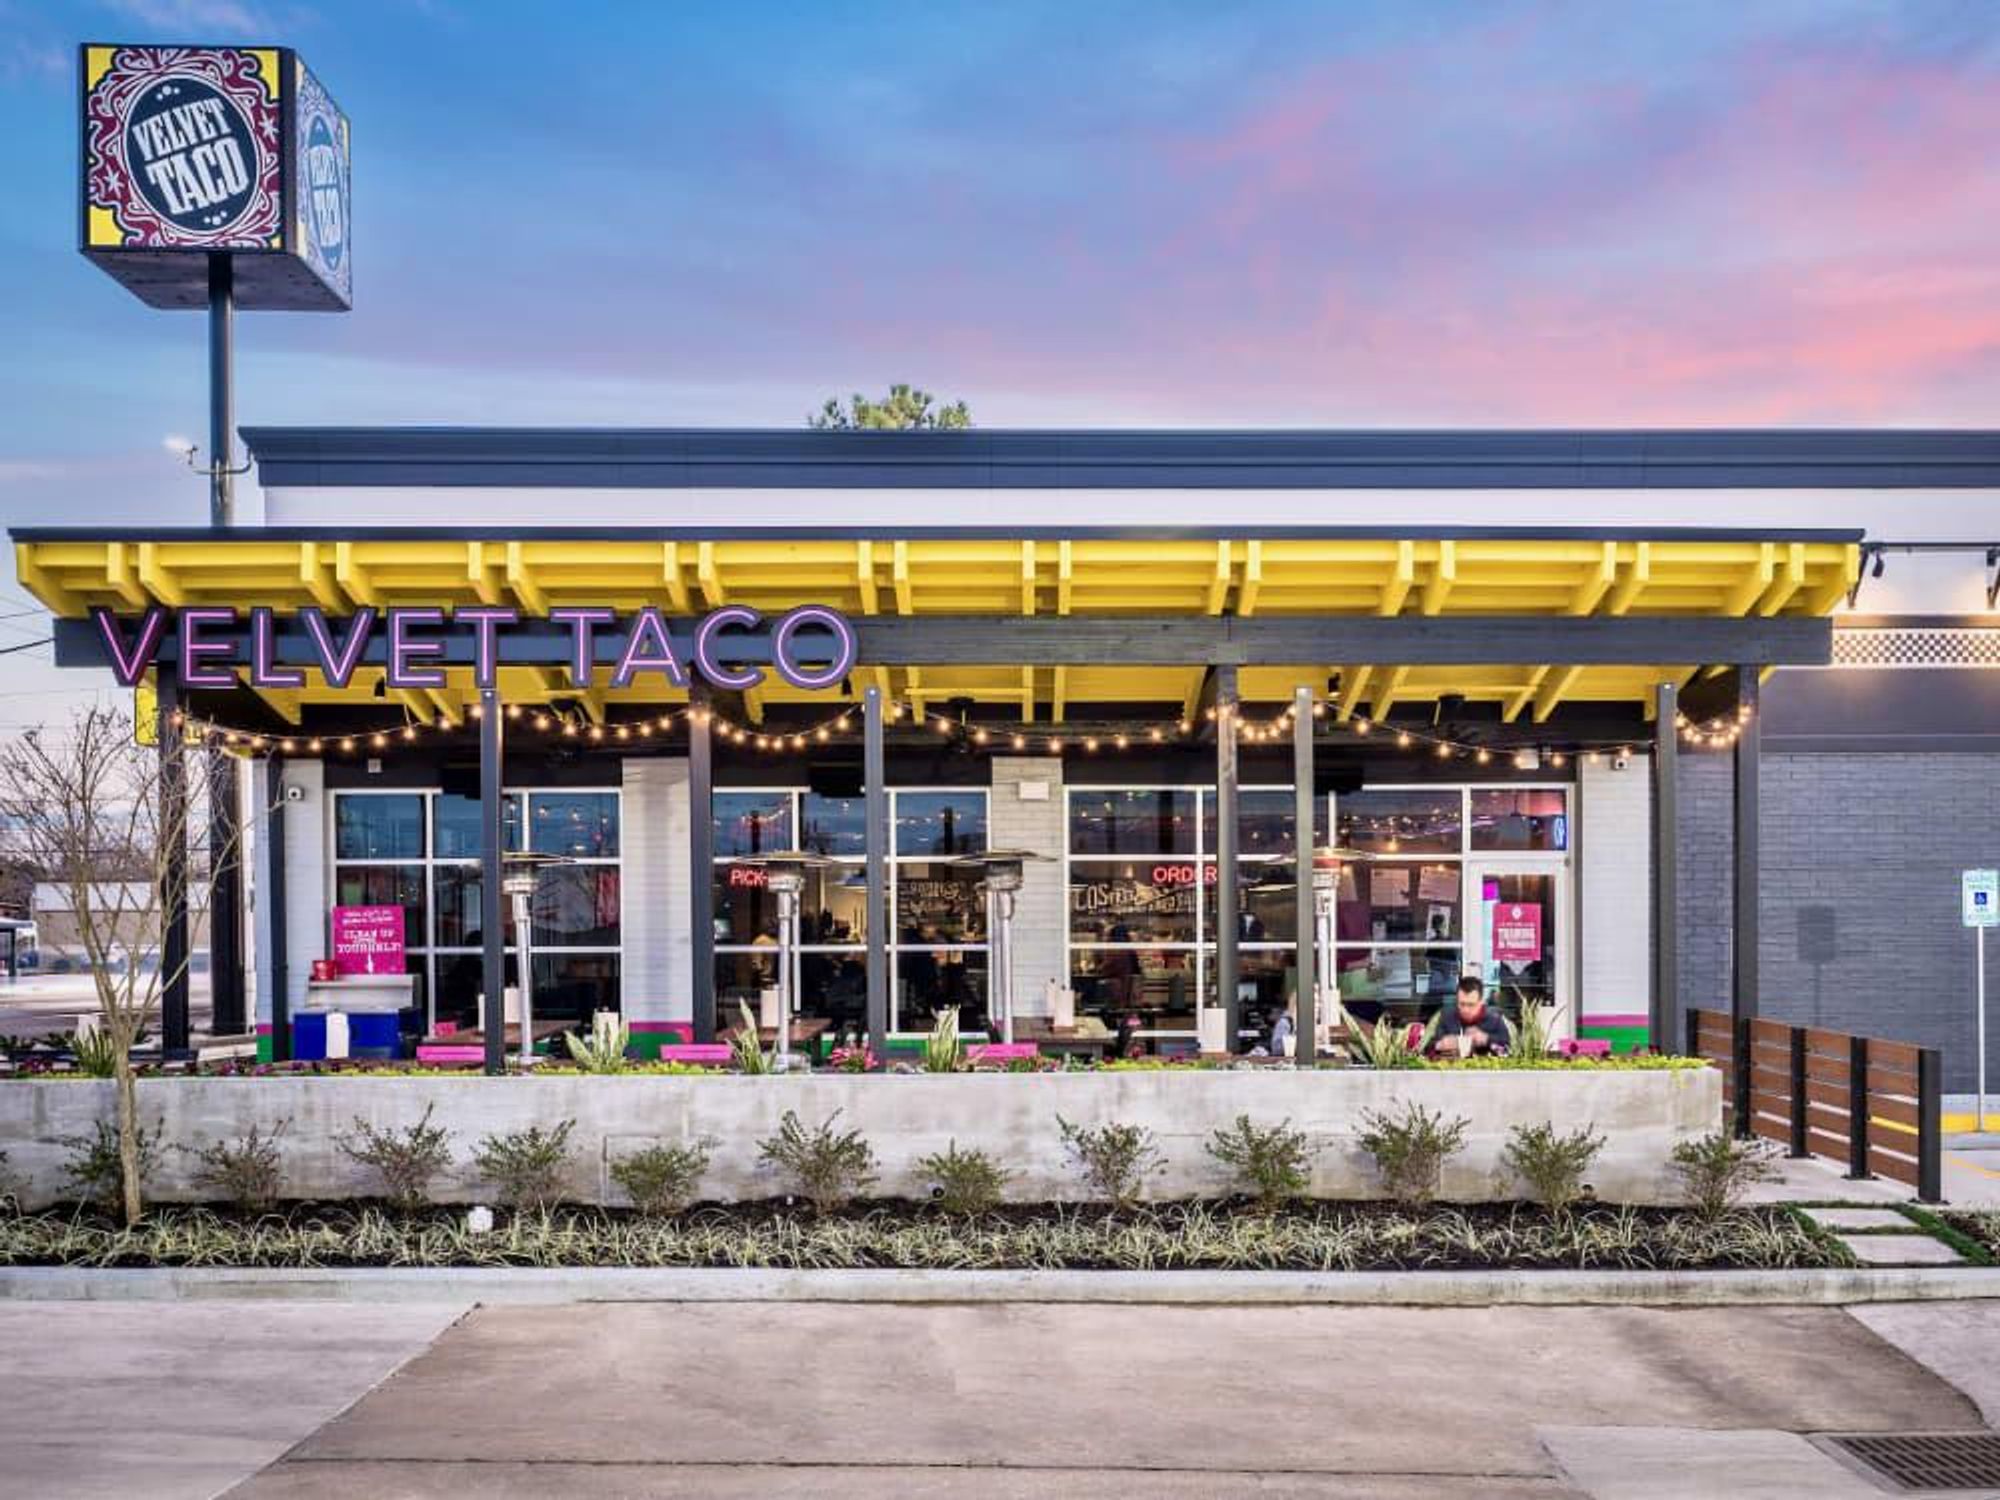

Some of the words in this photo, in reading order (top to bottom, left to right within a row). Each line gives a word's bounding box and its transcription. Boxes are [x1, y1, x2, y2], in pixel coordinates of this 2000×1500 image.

[132, 97, 232, 161] VELVET
[145, 136, 249, 215] TACO
[92, 606, 518, 688] VELVET
[549, 604, 859, 690] TACO
[1152, 865, 1218, 884] ORDR
